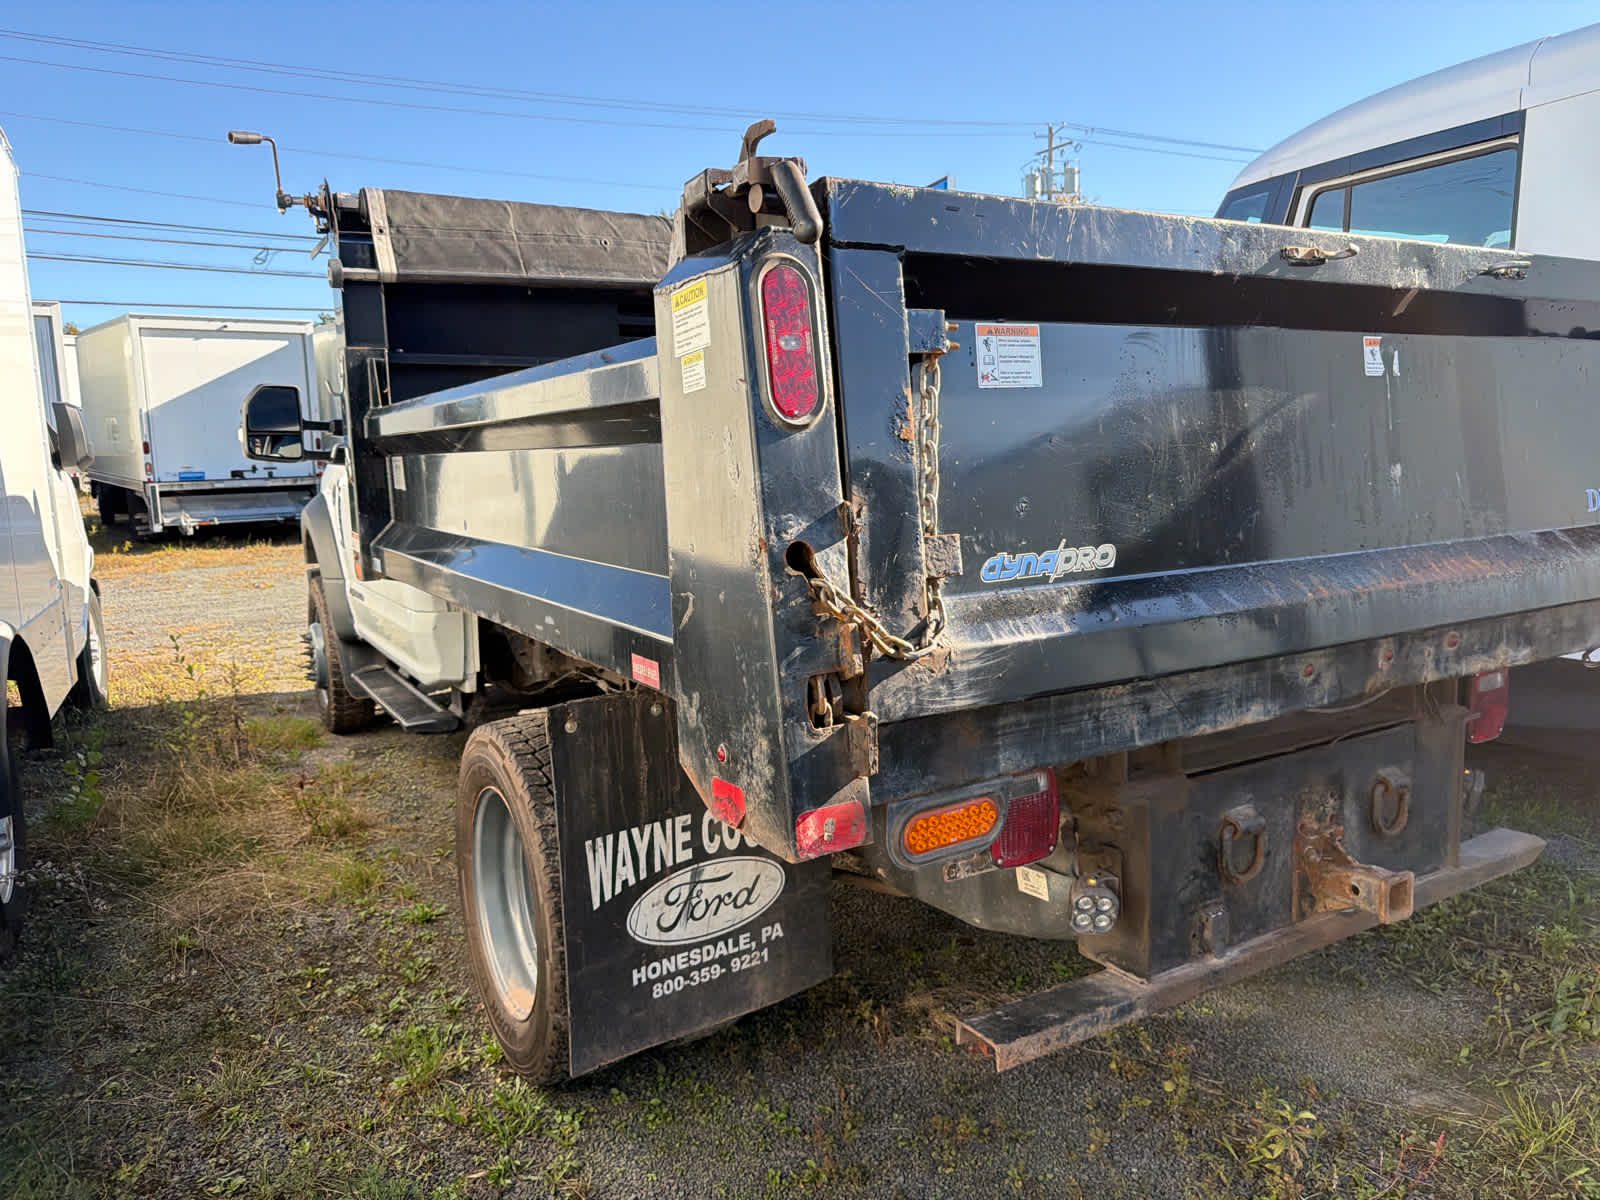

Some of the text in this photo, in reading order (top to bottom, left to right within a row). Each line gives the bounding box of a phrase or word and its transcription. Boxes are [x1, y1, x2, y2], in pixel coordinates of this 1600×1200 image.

[679, 286, 705, 305] CAUTION
[993, 327, 1029, 336] WARNING
[585, 809, 760, 911] WAYNE CO
[656, 871, 762, 933] Ford
[632, 922, 785, 987] HONESDALE, PA
[651, 947, 770, 999] 800-359- 9221
